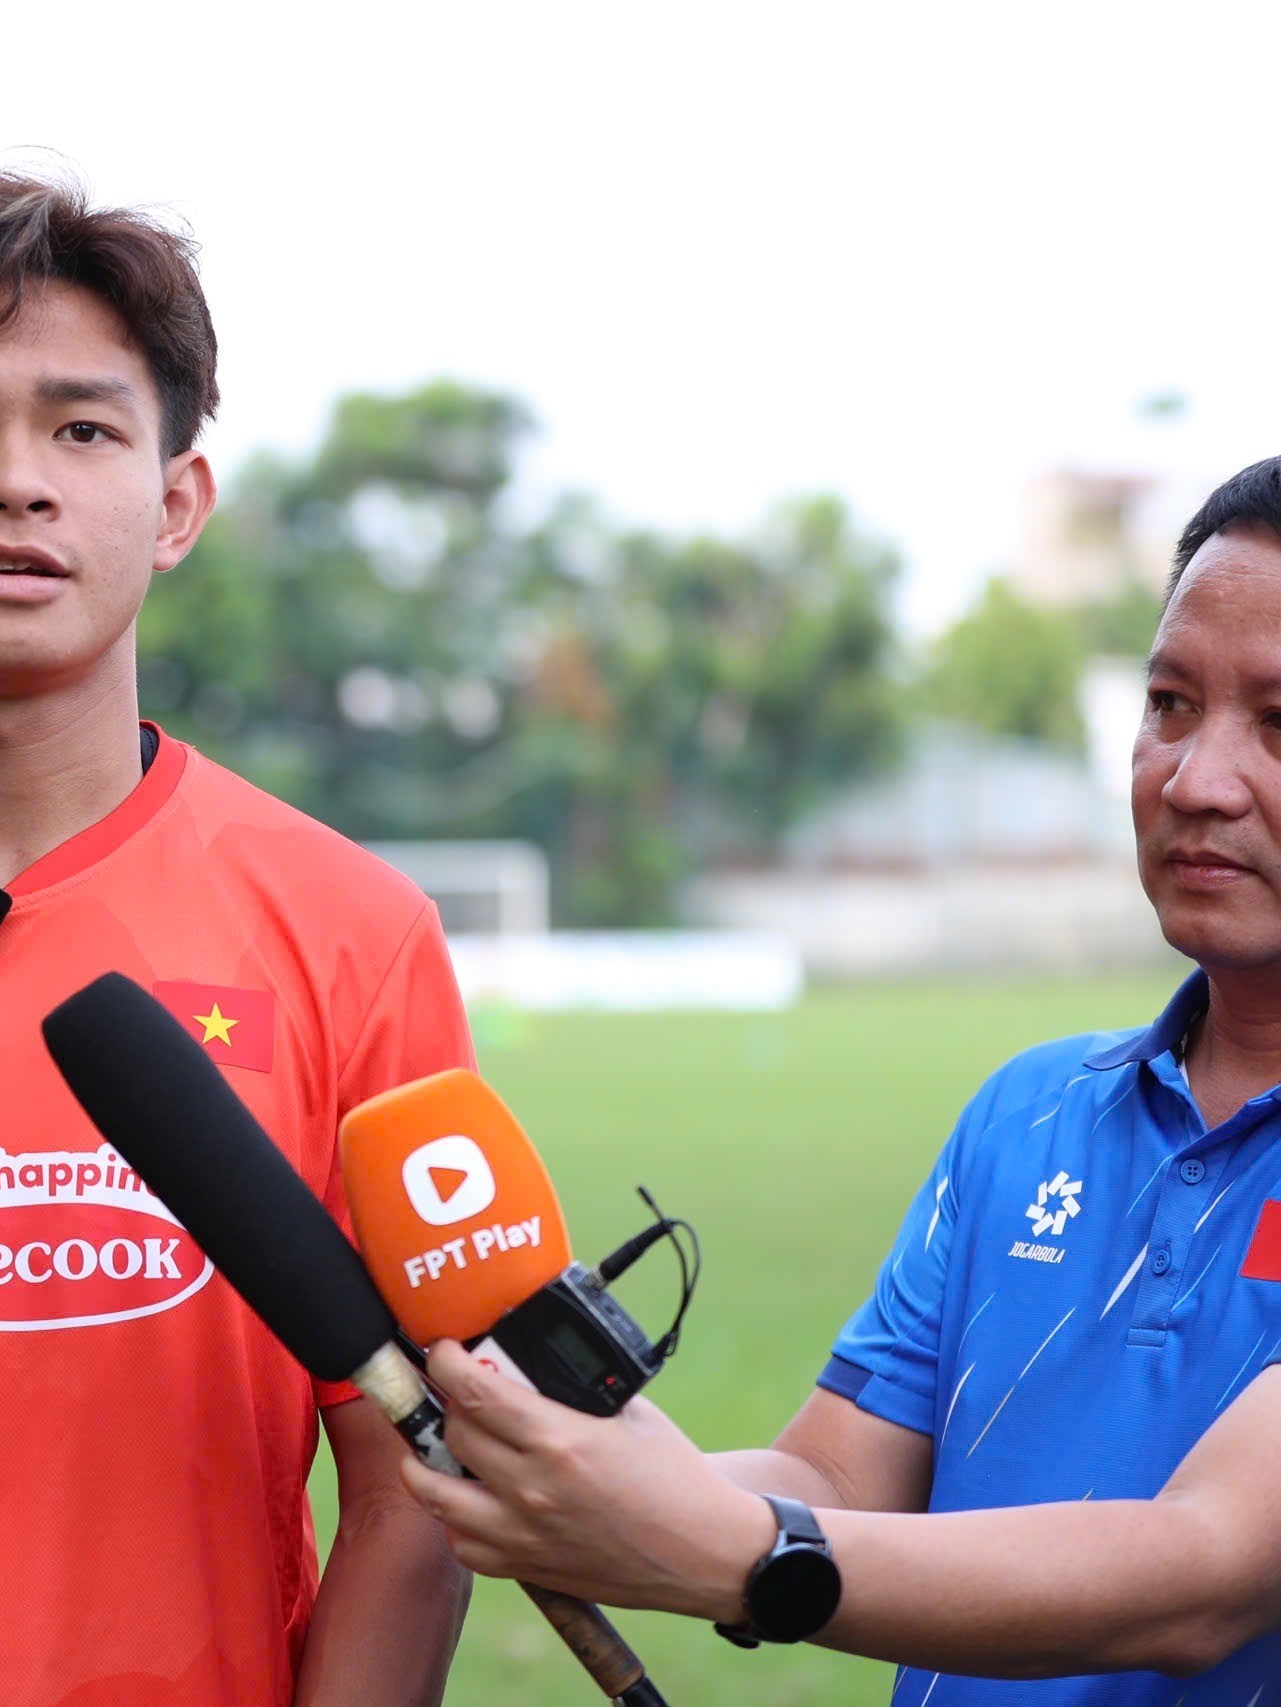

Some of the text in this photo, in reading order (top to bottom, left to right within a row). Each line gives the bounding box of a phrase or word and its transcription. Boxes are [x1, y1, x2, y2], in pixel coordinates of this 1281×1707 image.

[403, 1216, 542, 1289] FPT Play
[1007, 1241, 1066, 1264] JOGARBOLA
